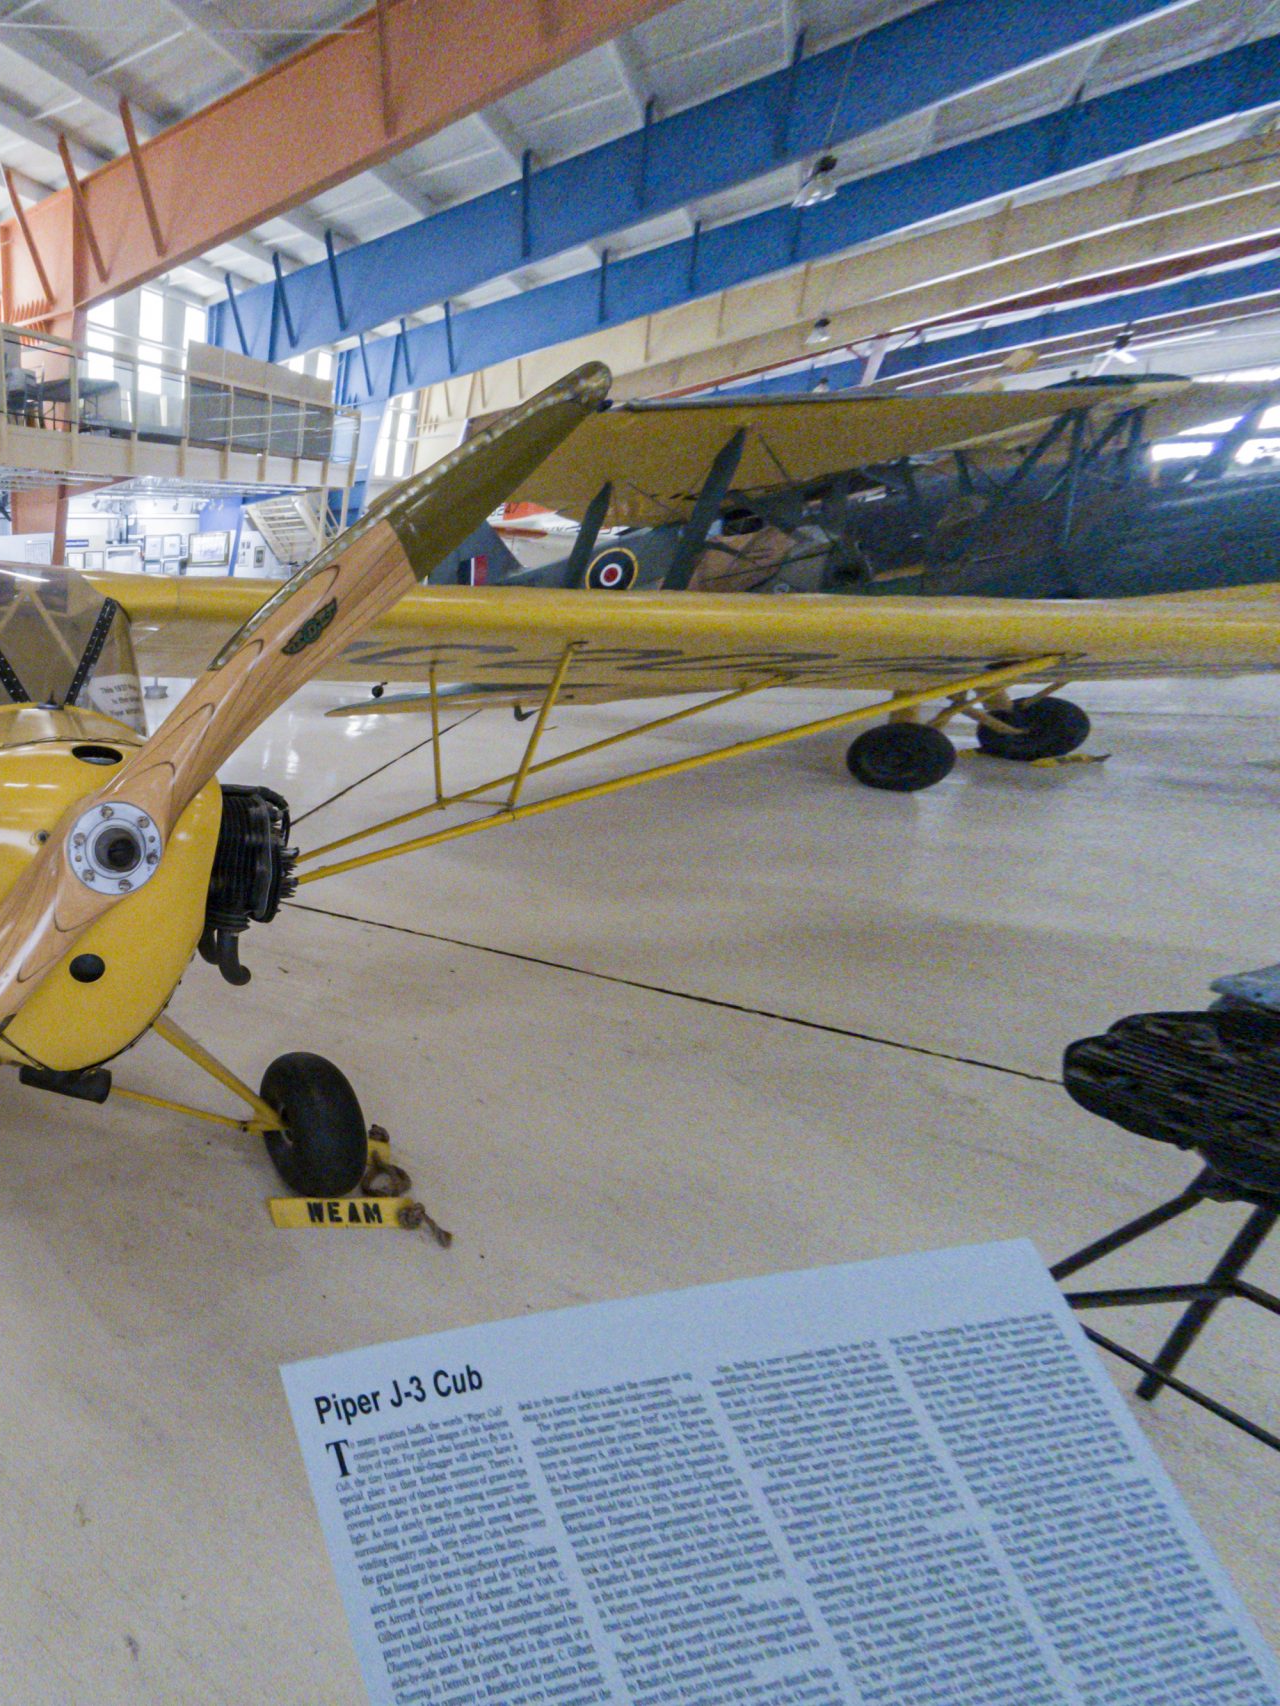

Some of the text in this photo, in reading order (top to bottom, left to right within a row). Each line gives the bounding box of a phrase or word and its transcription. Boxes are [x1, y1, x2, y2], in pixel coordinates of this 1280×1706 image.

[306, 1201, 383, 1224] WEAM
[314, 1365, 483, 1426] Piper J-3 Cub
